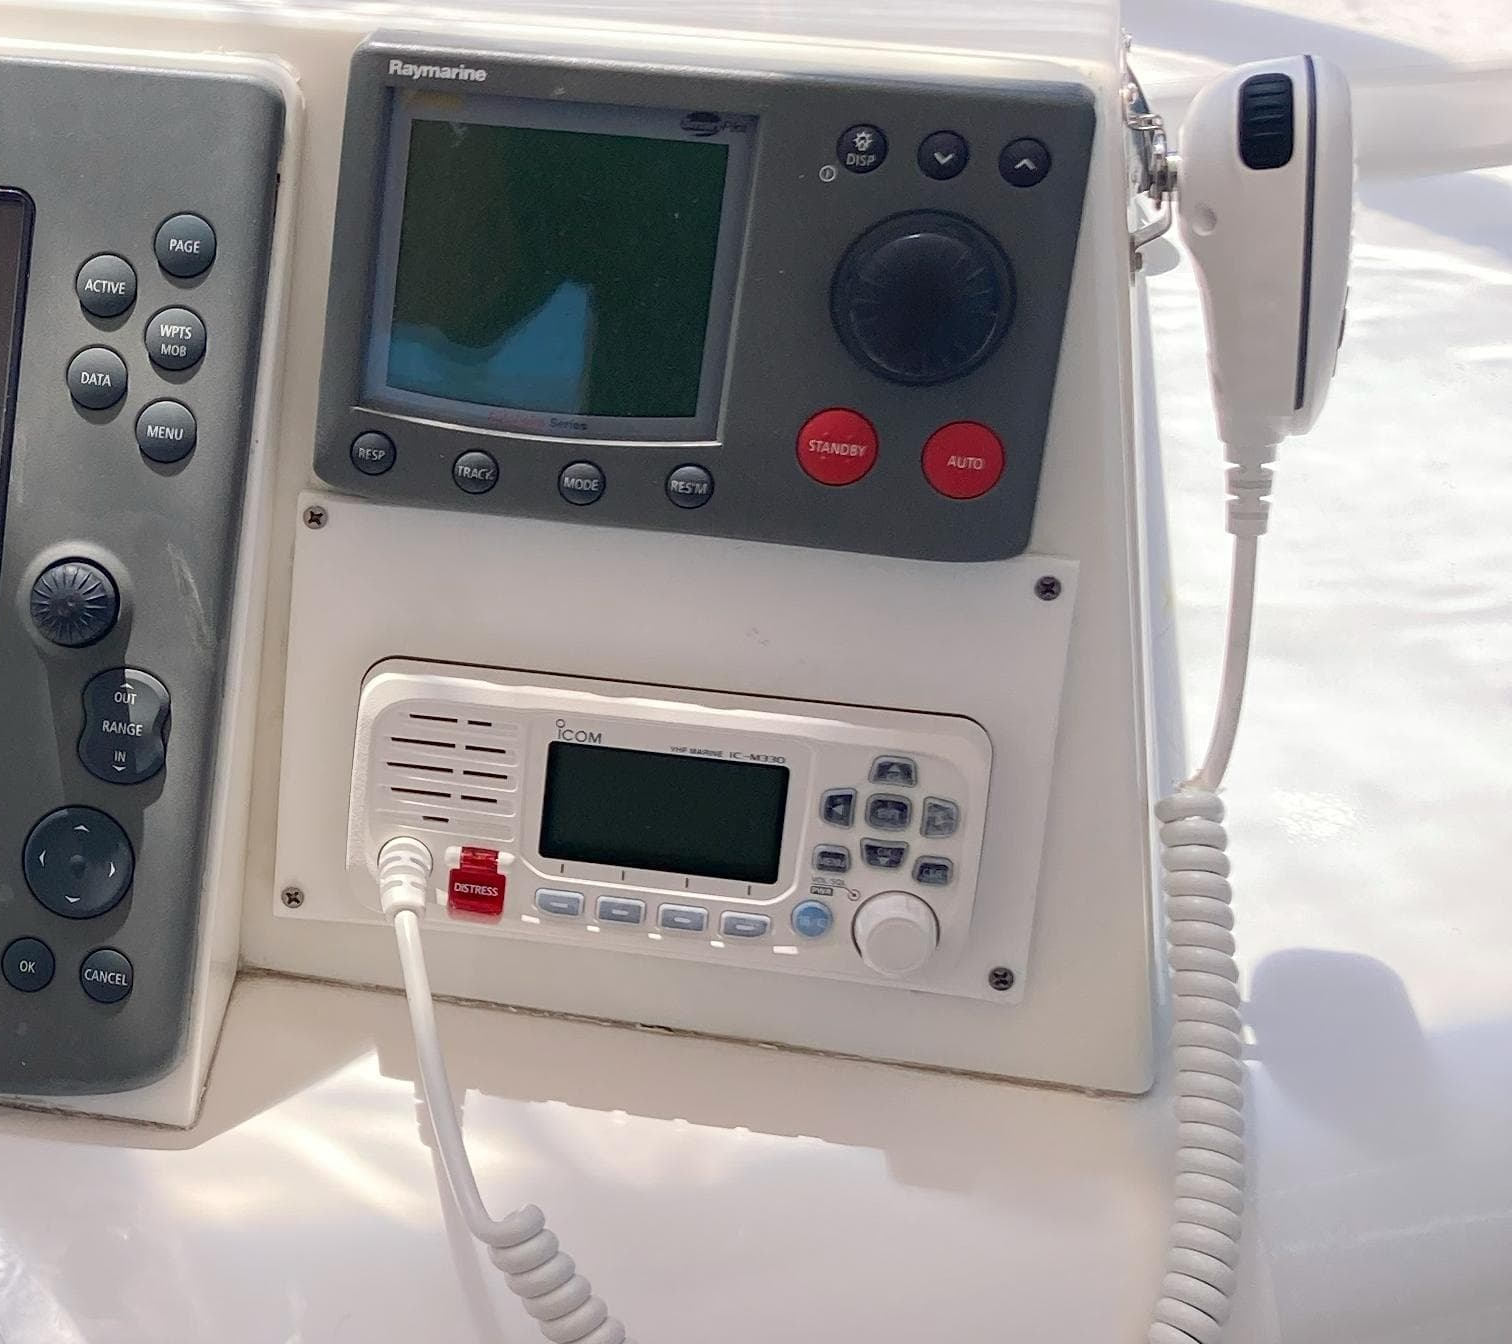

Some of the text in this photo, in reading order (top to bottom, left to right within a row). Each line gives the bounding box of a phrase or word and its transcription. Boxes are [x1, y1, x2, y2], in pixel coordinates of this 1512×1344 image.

[389, 59, 488, 82] Raymarine
[846, 153, 876, 167] DISP
[169, 238, 200, 254] PAGE
[84, 279, 126, 295] ACTIVE
[160, 324, 192, 339] WPTS
[161, 343, 187, 357] MOB
[81, 372, 111, 387] DATA
[146, 425, 183, 440] MENU
[358, 447, 386, 461] RESP
[808, 439, 867, 457] STANDBY
[947, 455, 984, 470] AUTO
[457, 465, 494, 480] TRACK
[563, 476, 600, 492] MODE
[114, 691, 136, 706] OUT
[102, 720, 143, 737] RANGE
[114, 750, 126, 764] IN
[454, 882, 498, 896] DISTRESS
[19, 960, 36, 975] OK
[84, 968, 128, 987] CANCEL
